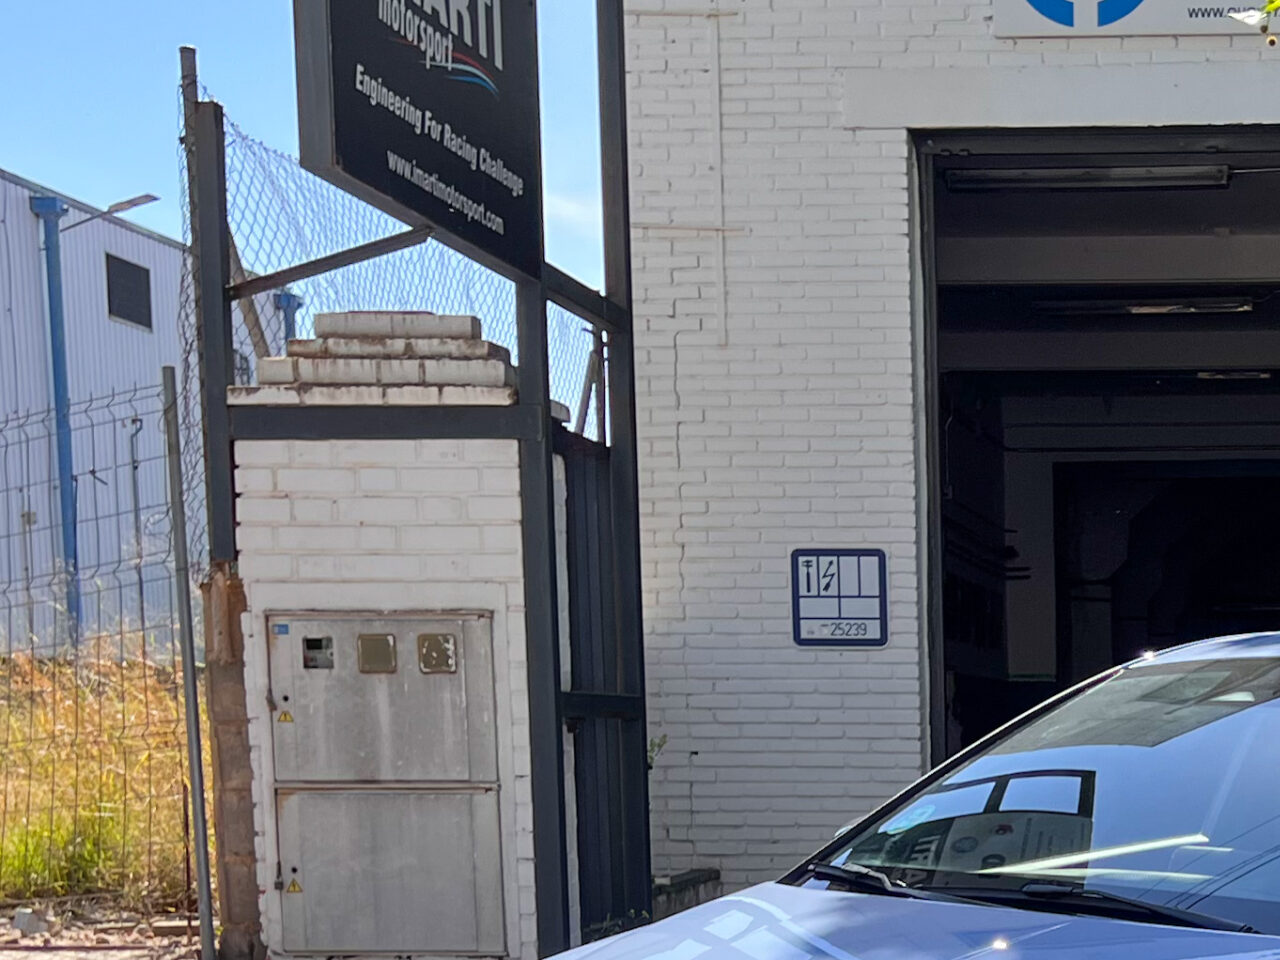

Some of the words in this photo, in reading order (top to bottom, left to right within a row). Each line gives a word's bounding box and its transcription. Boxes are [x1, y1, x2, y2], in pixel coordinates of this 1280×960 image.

[355, 64, 421, 135] Engineering
[424, 109, 443, 143] For
[444, 123, 477, 172] Racing
[479, 147, 524, 197] Challenge
[387, 150, 504, 236] www.imartimotorsport.com
[830, 622, 867, 636] 25239
